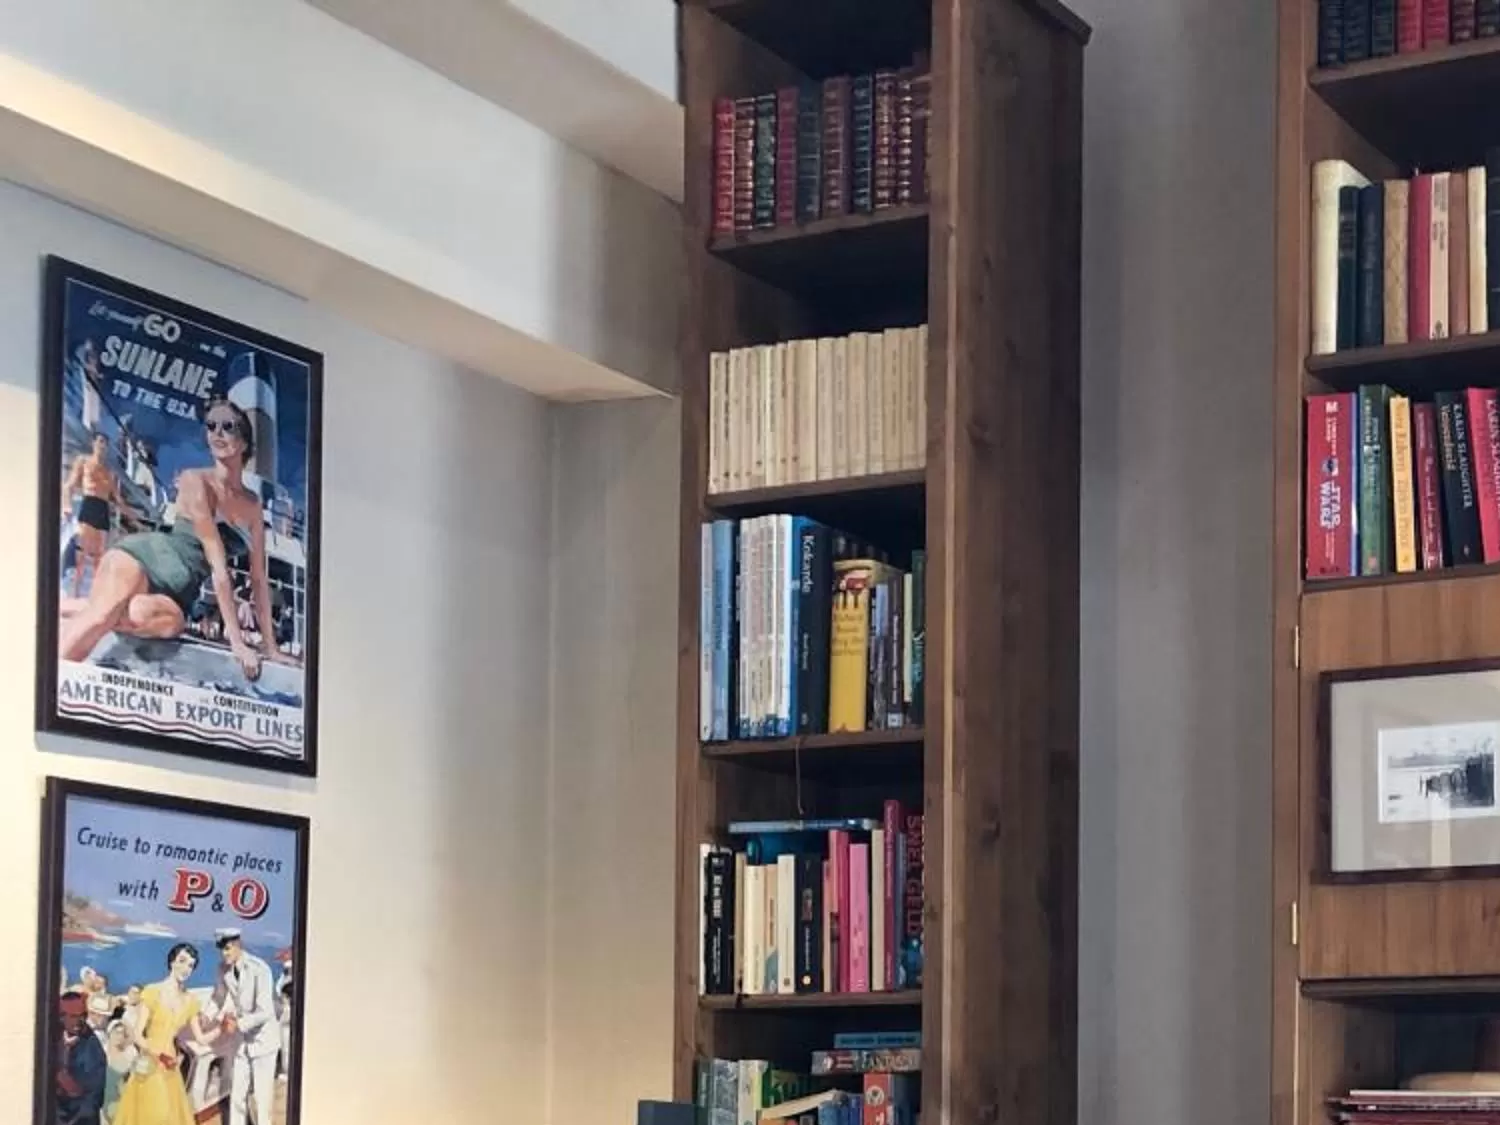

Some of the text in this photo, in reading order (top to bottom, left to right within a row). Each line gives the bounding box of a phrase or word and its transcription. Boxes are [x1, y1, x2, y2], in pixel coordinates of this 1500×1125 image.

[143, 312, 181, 343] GO
[101, 335, 218, 399] SUNLANE
[112, 379, 131, 399] TO
[135, 387, 165, 409] THE
[1486, 400, 1500, 439] KARIN
[1457, 443, 1473, 508] SLAUGHTER
[1319, 482, 1331, 529] WARS
[1330, 480, 1342, 526] STAR
[802, 535, 815, 593] Kokarde
[101, 672, 174, 696] INDEPENDENCE
[213, 695, 279, 717] CONSTITUTION
[59, 679, 303, 742] AMERICAN EXPORT LINES
[77, 826, 283, 873] Cruise to romantic places
[118, 879, 159, 901] with
[905, 816, 922, 935] SNEL GELD
